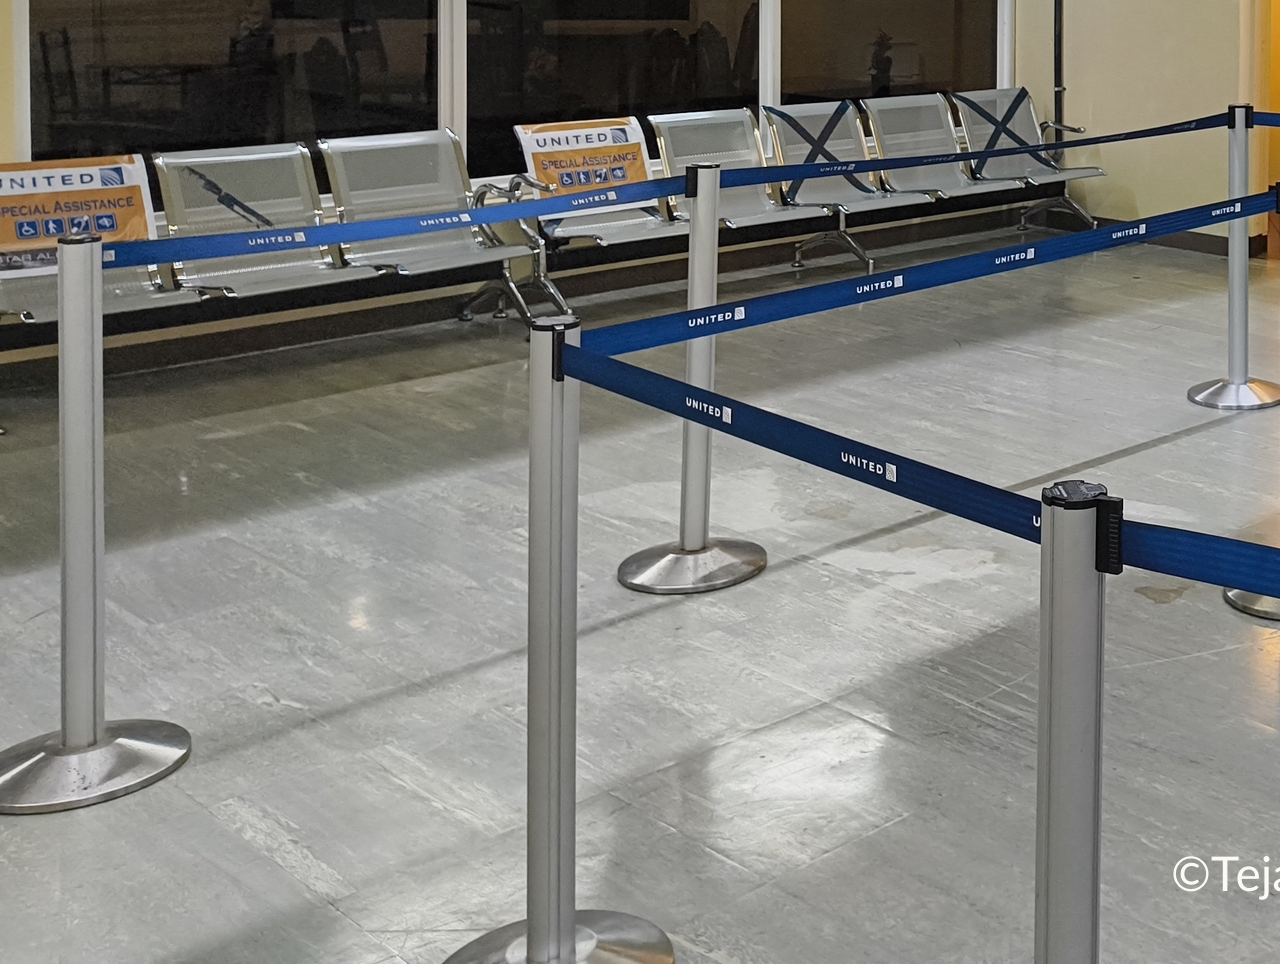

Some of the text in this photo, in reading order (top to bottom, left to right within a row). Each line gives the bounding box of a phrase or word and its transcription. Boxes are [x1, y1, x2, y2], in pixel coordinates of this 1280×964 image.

[536, 133, 608, 149] UNITED
[541, 151, 638, 171] SPECIAL ASSISTANCE
[0, 173, 95, 190] NITED
[0, 196, 135, 218] PECIAL ASSISTANCE
[571, 194, 607, 206] UNITED
[1211, 205, 1235, 217] UNITED
[419, 216, 460, 227] UNITED
[248, 236, 293, 246] UNITED
[1112, 228, 1139, 239] UNITED
[995, 251, 1026, 265] UNITED
[857, 279, 894, 294] UNITED
[688, 311, 733, 327] UNITED
[685, 396, 721, 419] UNITED
[840, 451, 885, 476] UNITED
